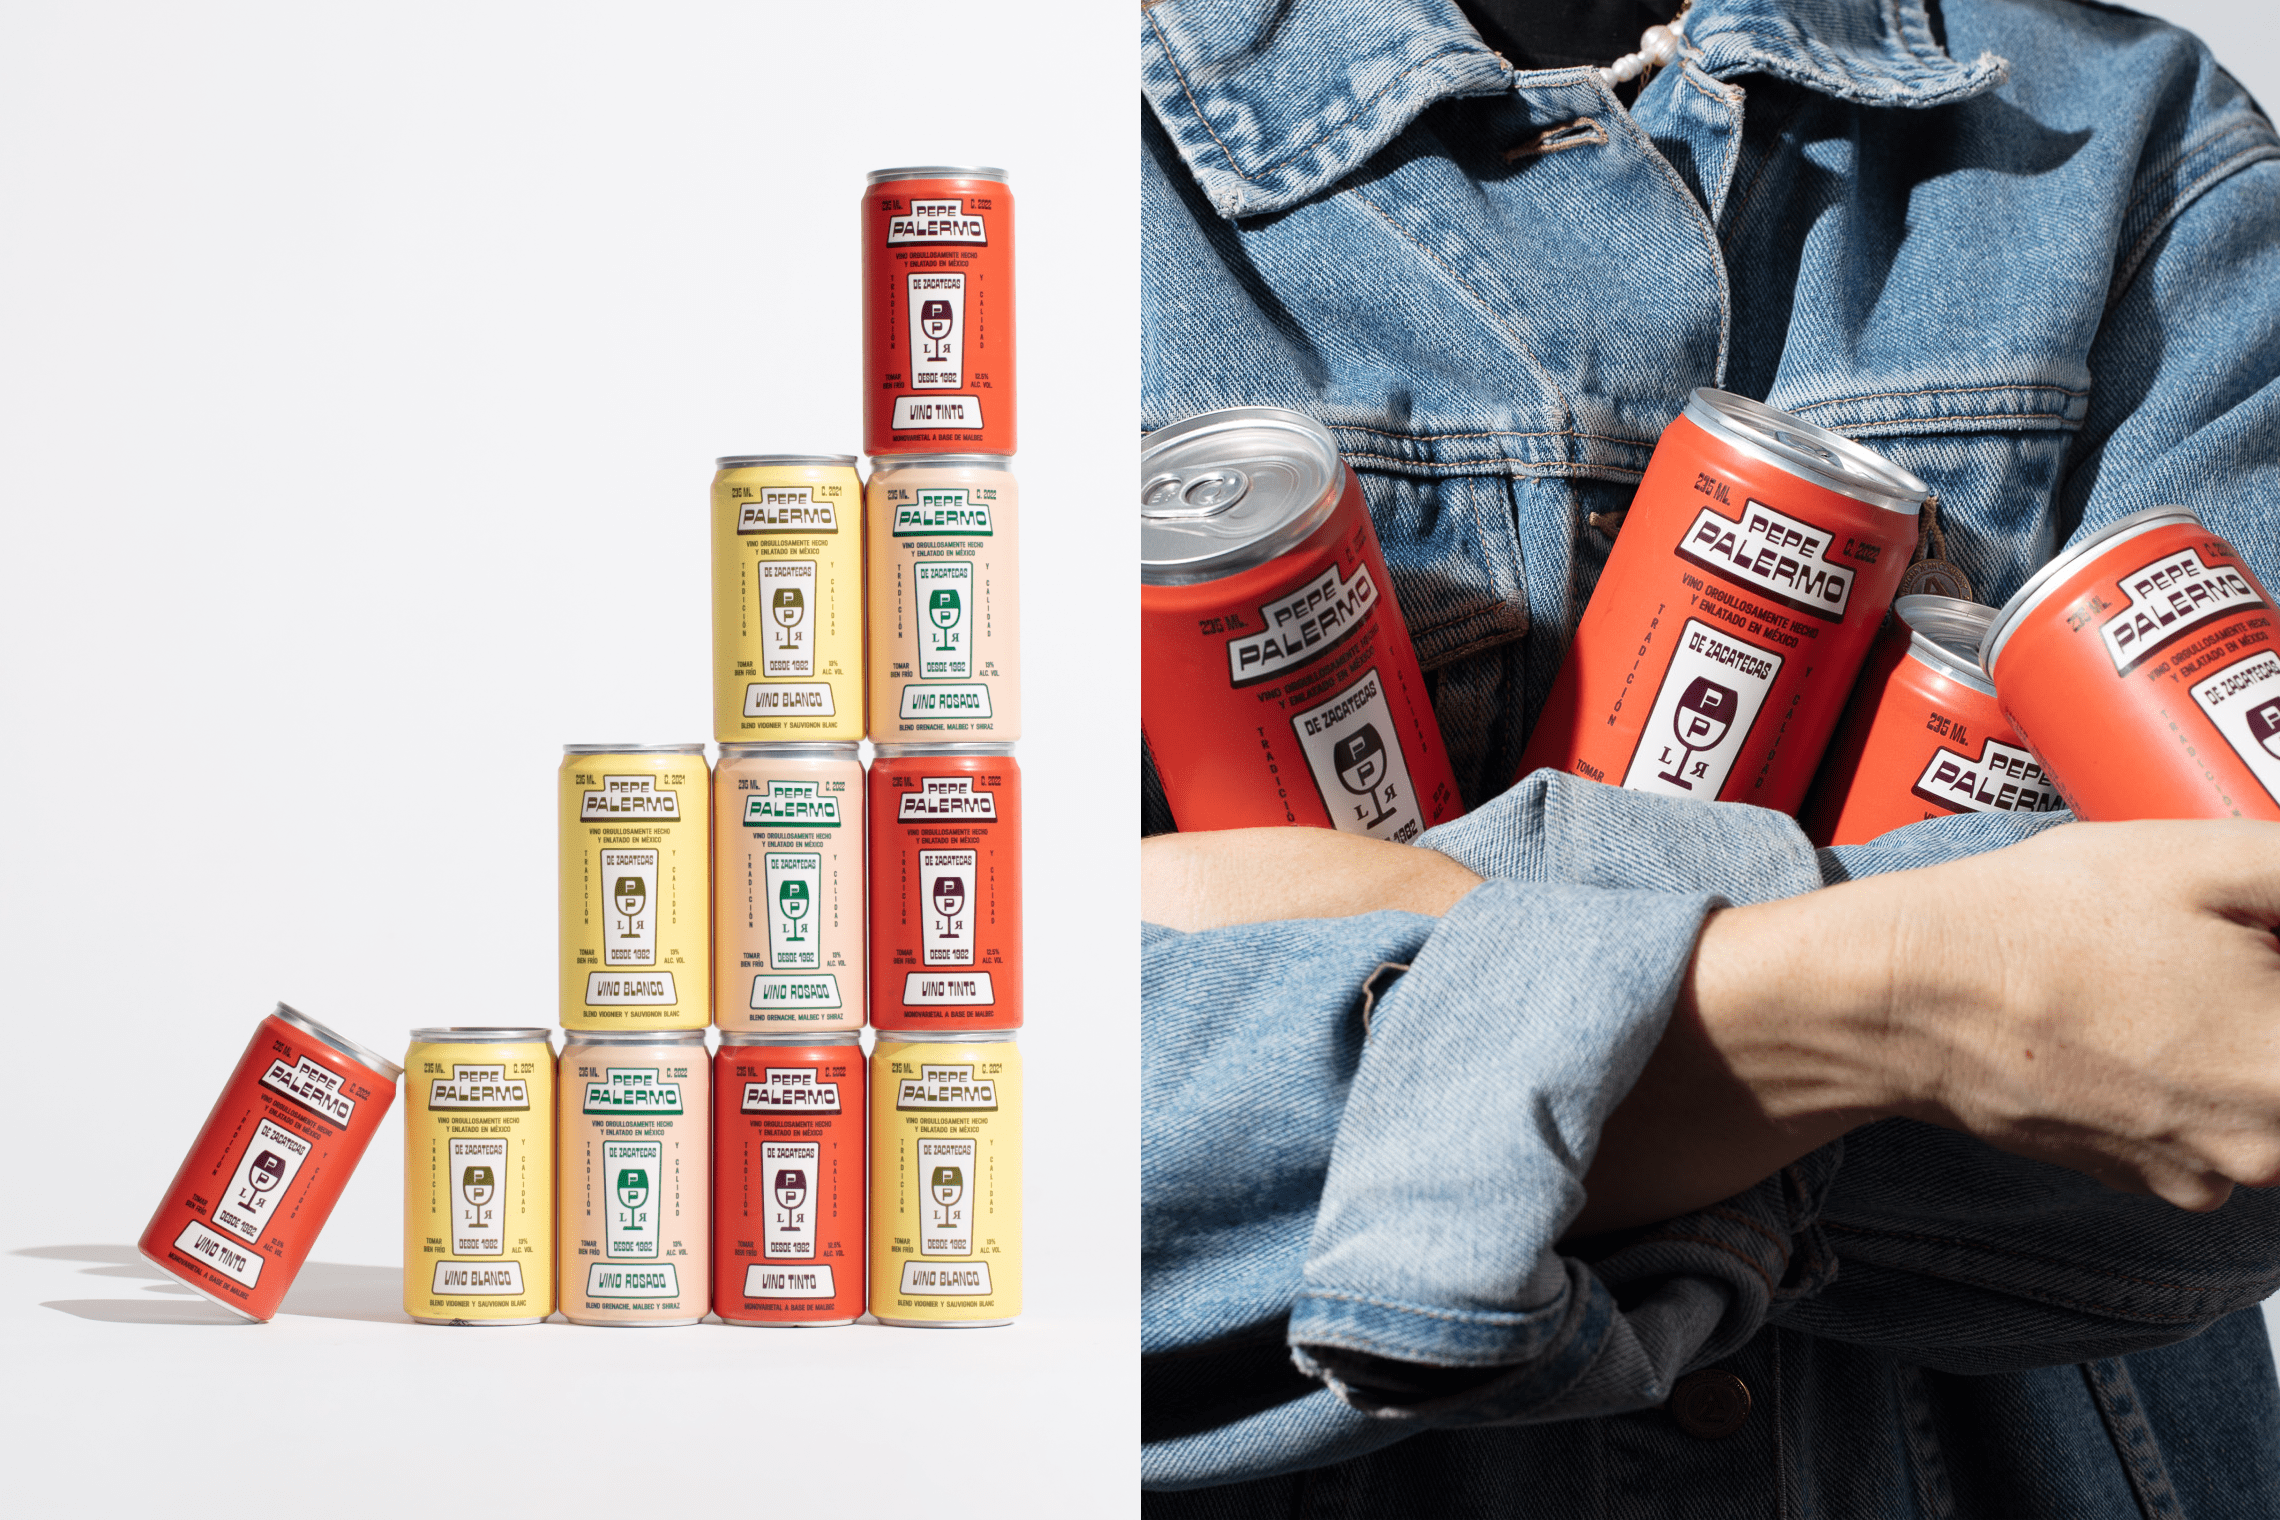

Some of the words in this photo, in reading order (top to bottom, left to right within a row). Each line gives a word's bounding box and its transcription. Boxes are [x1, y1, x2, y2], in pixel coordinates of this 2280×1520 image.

[917, 206, 956, 216] PEPE
[893, 221, 981, 236] PALERMO
[913, 280, 921, 289] DE
[923, 279, 960, 289] ZACATECAS
[918, 373, 939, 383] DESDE
[910, 405, 931, 420] VINO
[936, 405, 964, 419] TINTO
[1694, 472, 1714, 496] 235
[1714, 482, 1731, 506] ML.
[767, 494, 806, 504] PEPE
[924, 496, 962, 506] PEPE
[743, 509, 831, 524] PALERMO
[899, 511, 986, 526] PALERMO
[1749, 514, 1820, 558] PEPE
[1693, 521, 1845, 603] PALERMO
[764, 567, 772, 577] DE
[774, 567, 811, 577] ZACATECAS
[921, 569, 928, 578] DE
[930, 568, 967, 578] ZACATECAS
[2134, 559, 2200, 599] PEPE
[1274, 579, 1336, 627] PEPE
[1682, 572, 1704, 592] VINO
[1705, 584, 1789, 629] ORGULLOSAMENTE
[1790, 620, 1819, 639] HECHO
[1690, 594, 1699, 605] Y
[1699, 598, 1747, 628] ENLATADO
[1748, 621, 1762, 634] EN
[1763, 624, 1799, 648] MÉXICO
[2113, 574, 2251, 654] PALERMO
[1240, 576, 1371, 670] PALERMO
[2170, 622, 2248, 666] ORGULLOSAMENTE
[1689, 632, 1706, 653] DE
[1705, 639, 1772, 680] ZACATECAS
[2170, 672, 2179, 683] Y
[2180, 647, 2225, 677] ENLATADO
[2225, 640, 2239, 653] EN
[770, 661, 790, 670] DESDE
[2205, 686, 2225, 705] DE
[2220, 660, 2280, 696] ZACATECAS
[756, 693, 778, 708] VINO
[782, 692, 822, 707] BLANCO
[913, 694, 935, 709] VINO
[940, 694, 979, 708] ROSADO
[1304, 718, 1322, 736] DE
[1322, 680, 1377, 729] ZACATECAS
[1926, 712, 1952, 736] 235
[1950, 723, 1969, 746] ML.
[1257, 727, 1297, 827] TRADICIÓ
[1576, 758, 1604, 783] TOMAR
[610, 782, 649, 792] PEPE
[775, 788, 812, 798] PEPE
[928, 783, 967, 794] PEPE
[1931, 761, 2067, 812] PALERM
[586, 797, 674, 812] PALERMO
[750, 802, 835, 817] PALERMO
[904, 798, 991, 813] PALERMO
[607, 856, 614, 865] DE
[616, 855, 653, 865] ZACATECAS
[771, 859, 779, 869] DE
[781, 859, 816, 869] ZACATECAS
[925, 855, 933, 865] DE
[935, 855, 972, 866] ZACATECAS
[598, 981, 620, 996] VINO
[624, 981, 664, 996] BLANCO
[763, 985, 786, 999] VINO
[791, 984, 829, 999] ROSADO
[922, 981, 944, 996] VINO
[948, 981, 976, 996] TINTO
[299, 1063, 337, 1091] PEPE
[459, 1071, 498, 1082] PEPE
[613, 1075, 652, 1086] PEPE
[772, 1074, 811, 1086] PEPE
[928, 1071, 967, 1082] PEPE
[268, 1065, 349, 1118] PALERMO
[435, 1086, 524, 1101] PALERMO
[589, 1090, 676, 1105] PALERMO
[747, 1089, 835, 1105] PALERMO
[903, 1086, 992, 1102] PALERMO
[261, 1125, 271, 1136] DE
[271, 1130, 306, 1155] ZACATECAS
[455, 1145, 463, 1154] DE
[465, 1145, 502, 1155] ZACATECAS
[610, 1147, 617, 1158] DE
[619, 1148, 656, 1158] ZACATECAS
[767, 1148, 775, 1158] DE
[777, 1148, 814, 1158] ZACATECAS
[924, 1145, 931, 1155] DE
[933, 1145, 971, 1155] ZACATECAS
[194, 1235, 218, 1258] VINO
[221, 1249, 247, 1272] TINTO
[444, 1271, 468, 1286] VINO
[471, 1270, 511, 1286] BLANCO
[599, 1273, 622, 1288] VINO
[626, 1273, 666, 1288] ROSADO
[762, 1274, 784, 1289] VINO
[788, 1274, 816, 1290] TINTO
[913, 1271, 936, 1286] VINO
[940, 1271, 980, 1286] BLANCO
